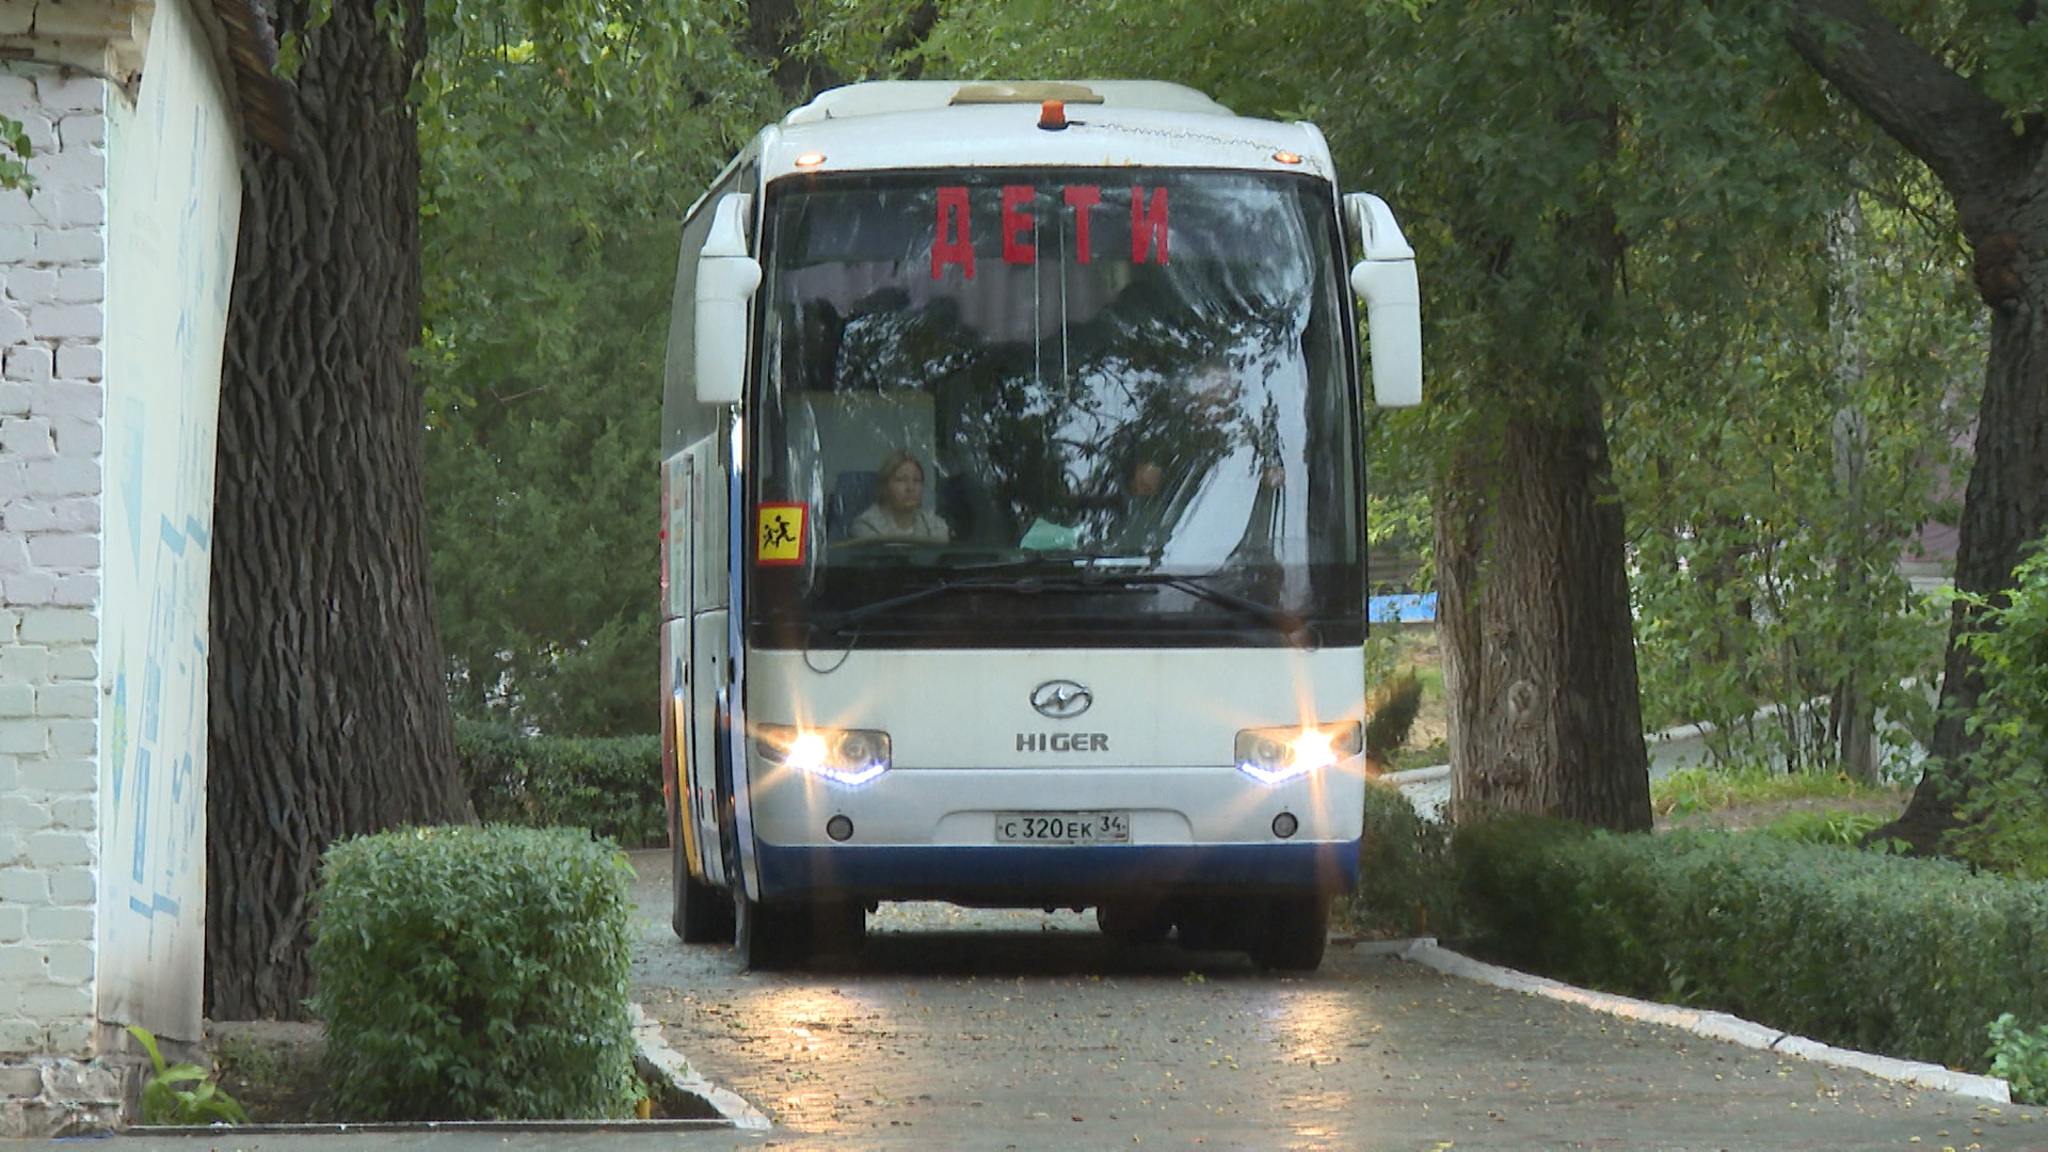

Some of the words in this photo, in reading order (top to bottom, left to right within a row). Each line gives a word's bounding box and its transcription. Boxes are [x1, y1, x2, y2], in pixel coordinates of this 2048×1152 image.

[931, 185, 1169, 279] ДЕТИ
[1016, 733, 1109, 751] HIGER
[1100, 816, 1121, 832] 34
